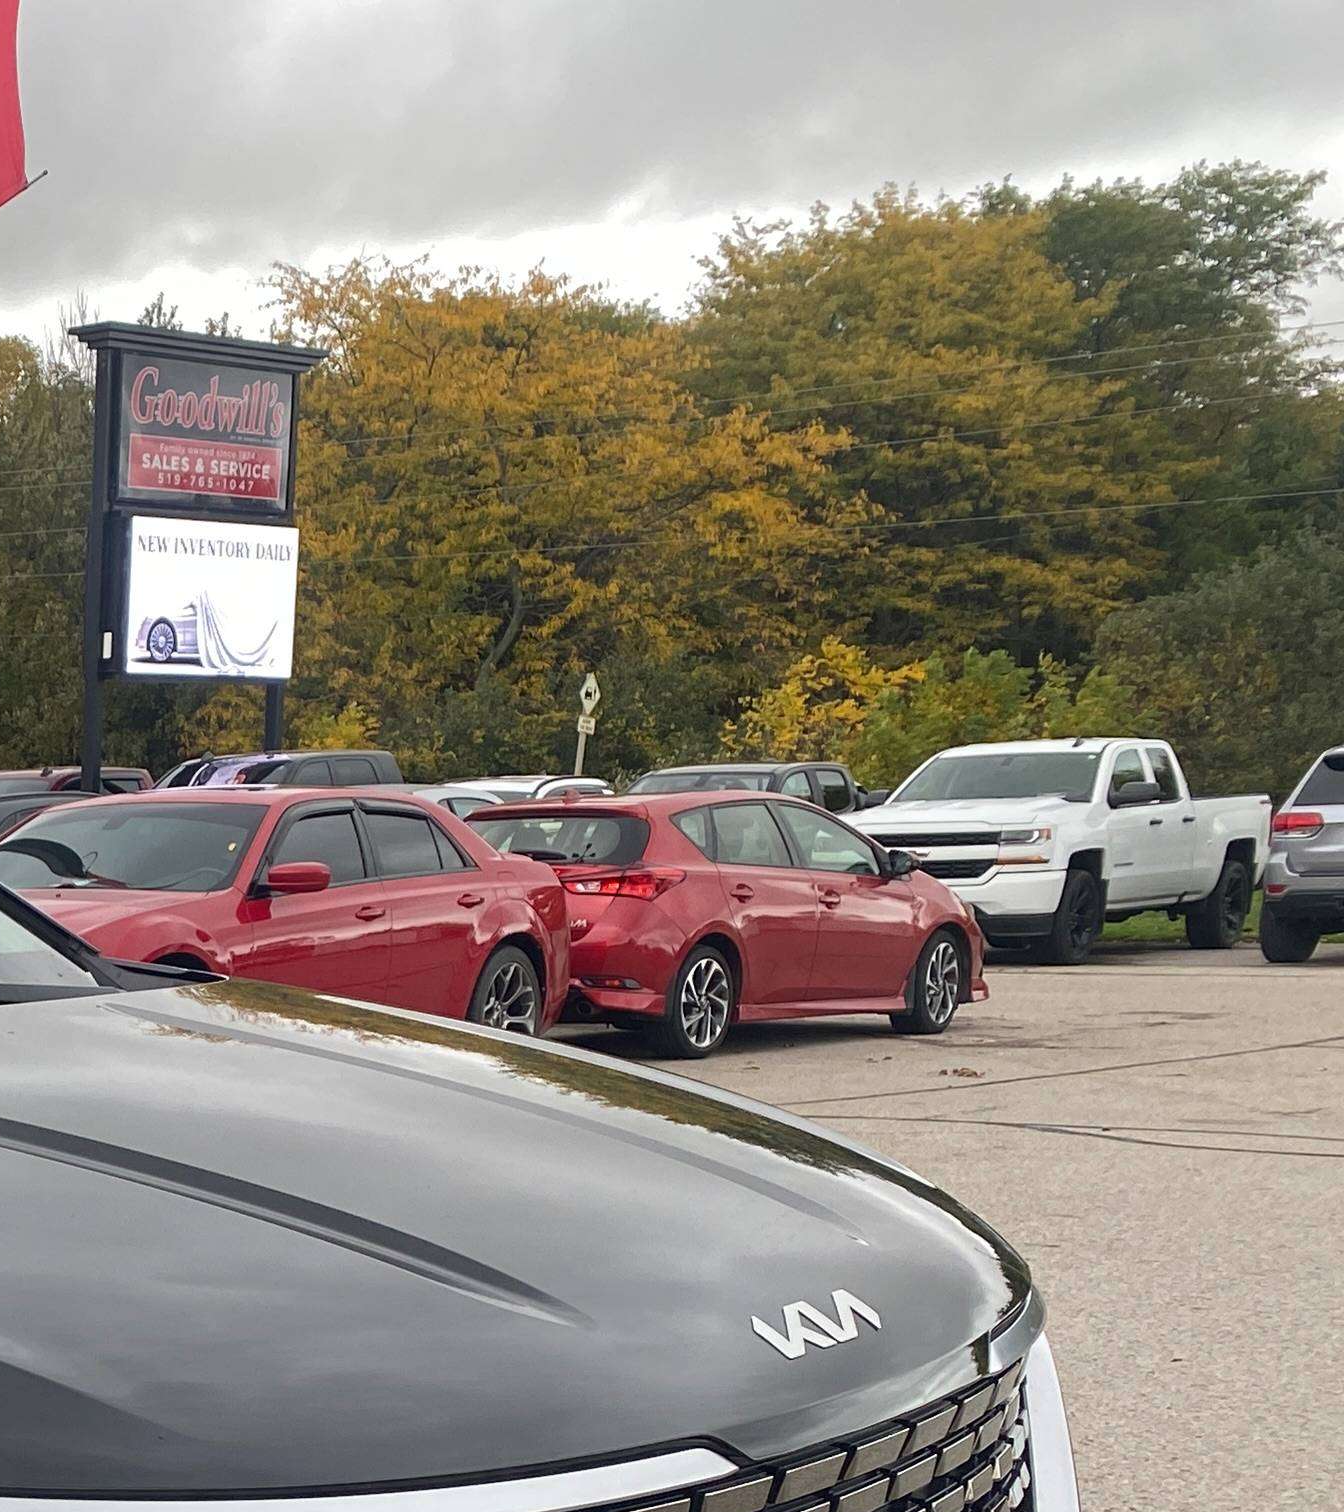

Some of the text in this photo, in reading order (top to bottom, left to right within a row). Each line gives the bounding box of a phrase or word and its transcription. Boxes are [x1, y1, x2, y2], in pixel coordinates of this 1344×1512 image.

[131, 366, 285, 438] Goodwill's
[142, 453, 271, 480] SALES & SERVICE
[158, 472, 254, 491] 519-765-1047
[138, 534, 293, 562] NEW INVENTORY DAILY
